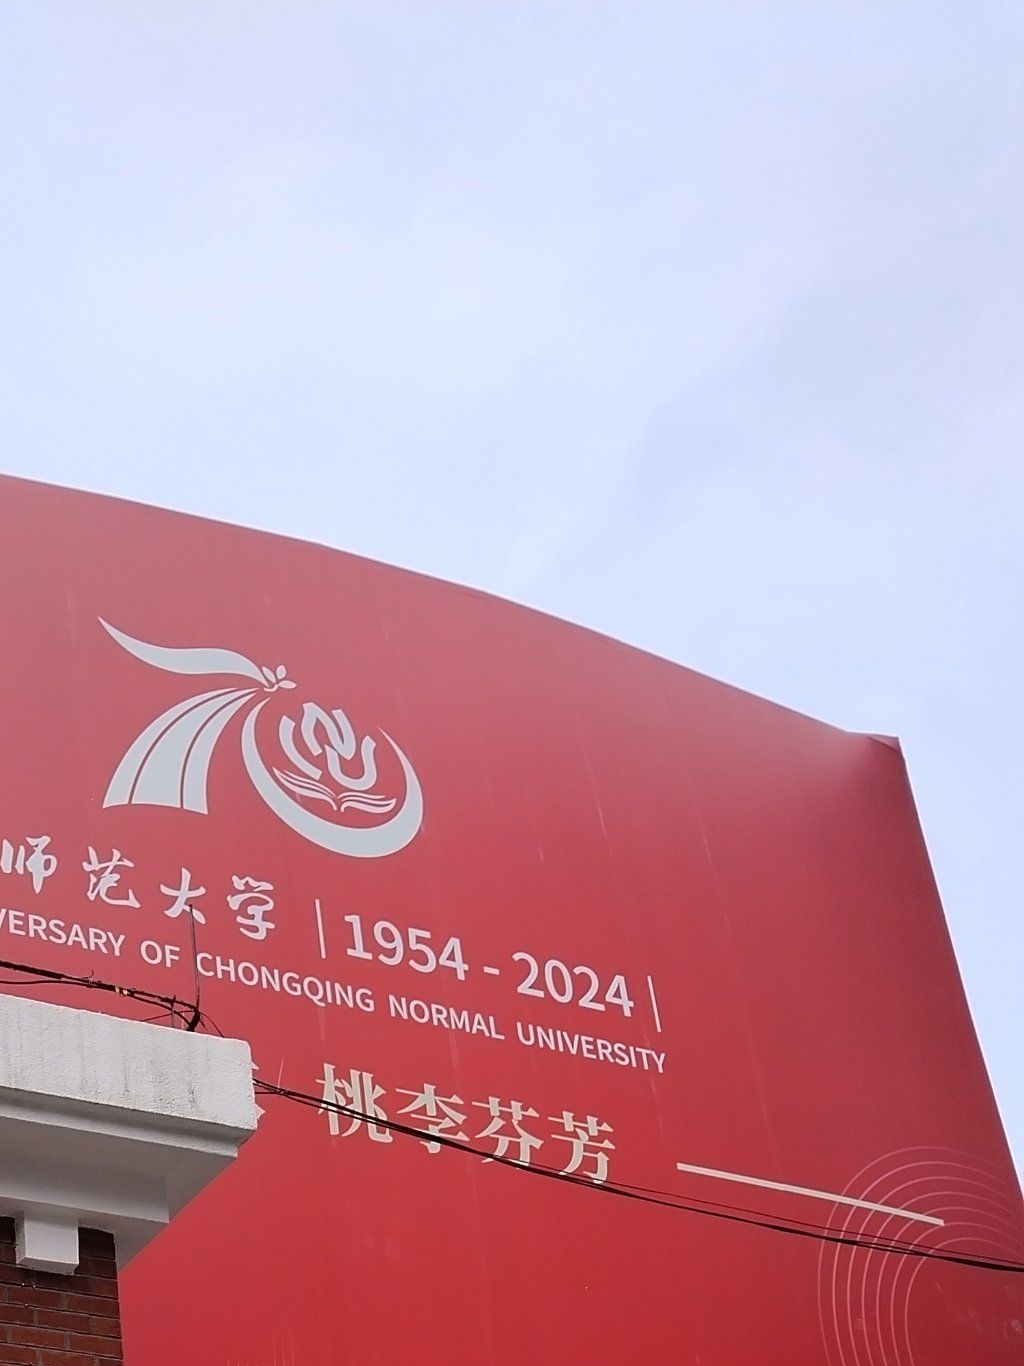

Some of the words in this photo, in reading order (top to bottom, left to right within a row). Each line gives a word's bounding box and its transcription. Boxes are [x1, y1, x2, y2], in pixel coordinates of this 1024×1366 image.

[140, 940, 181, 969] OF
[196, 951, 375, 1012] CHONGQING
[388, 994, 506, 1041] NORMAL
[516, 1021, 667, 1074] UNIVERSITY
[343, 914, 469, 981] 1954
[512, 951, 635, 1018] 2024
[316, 1062, 617, 1185] 桃李芬芳
